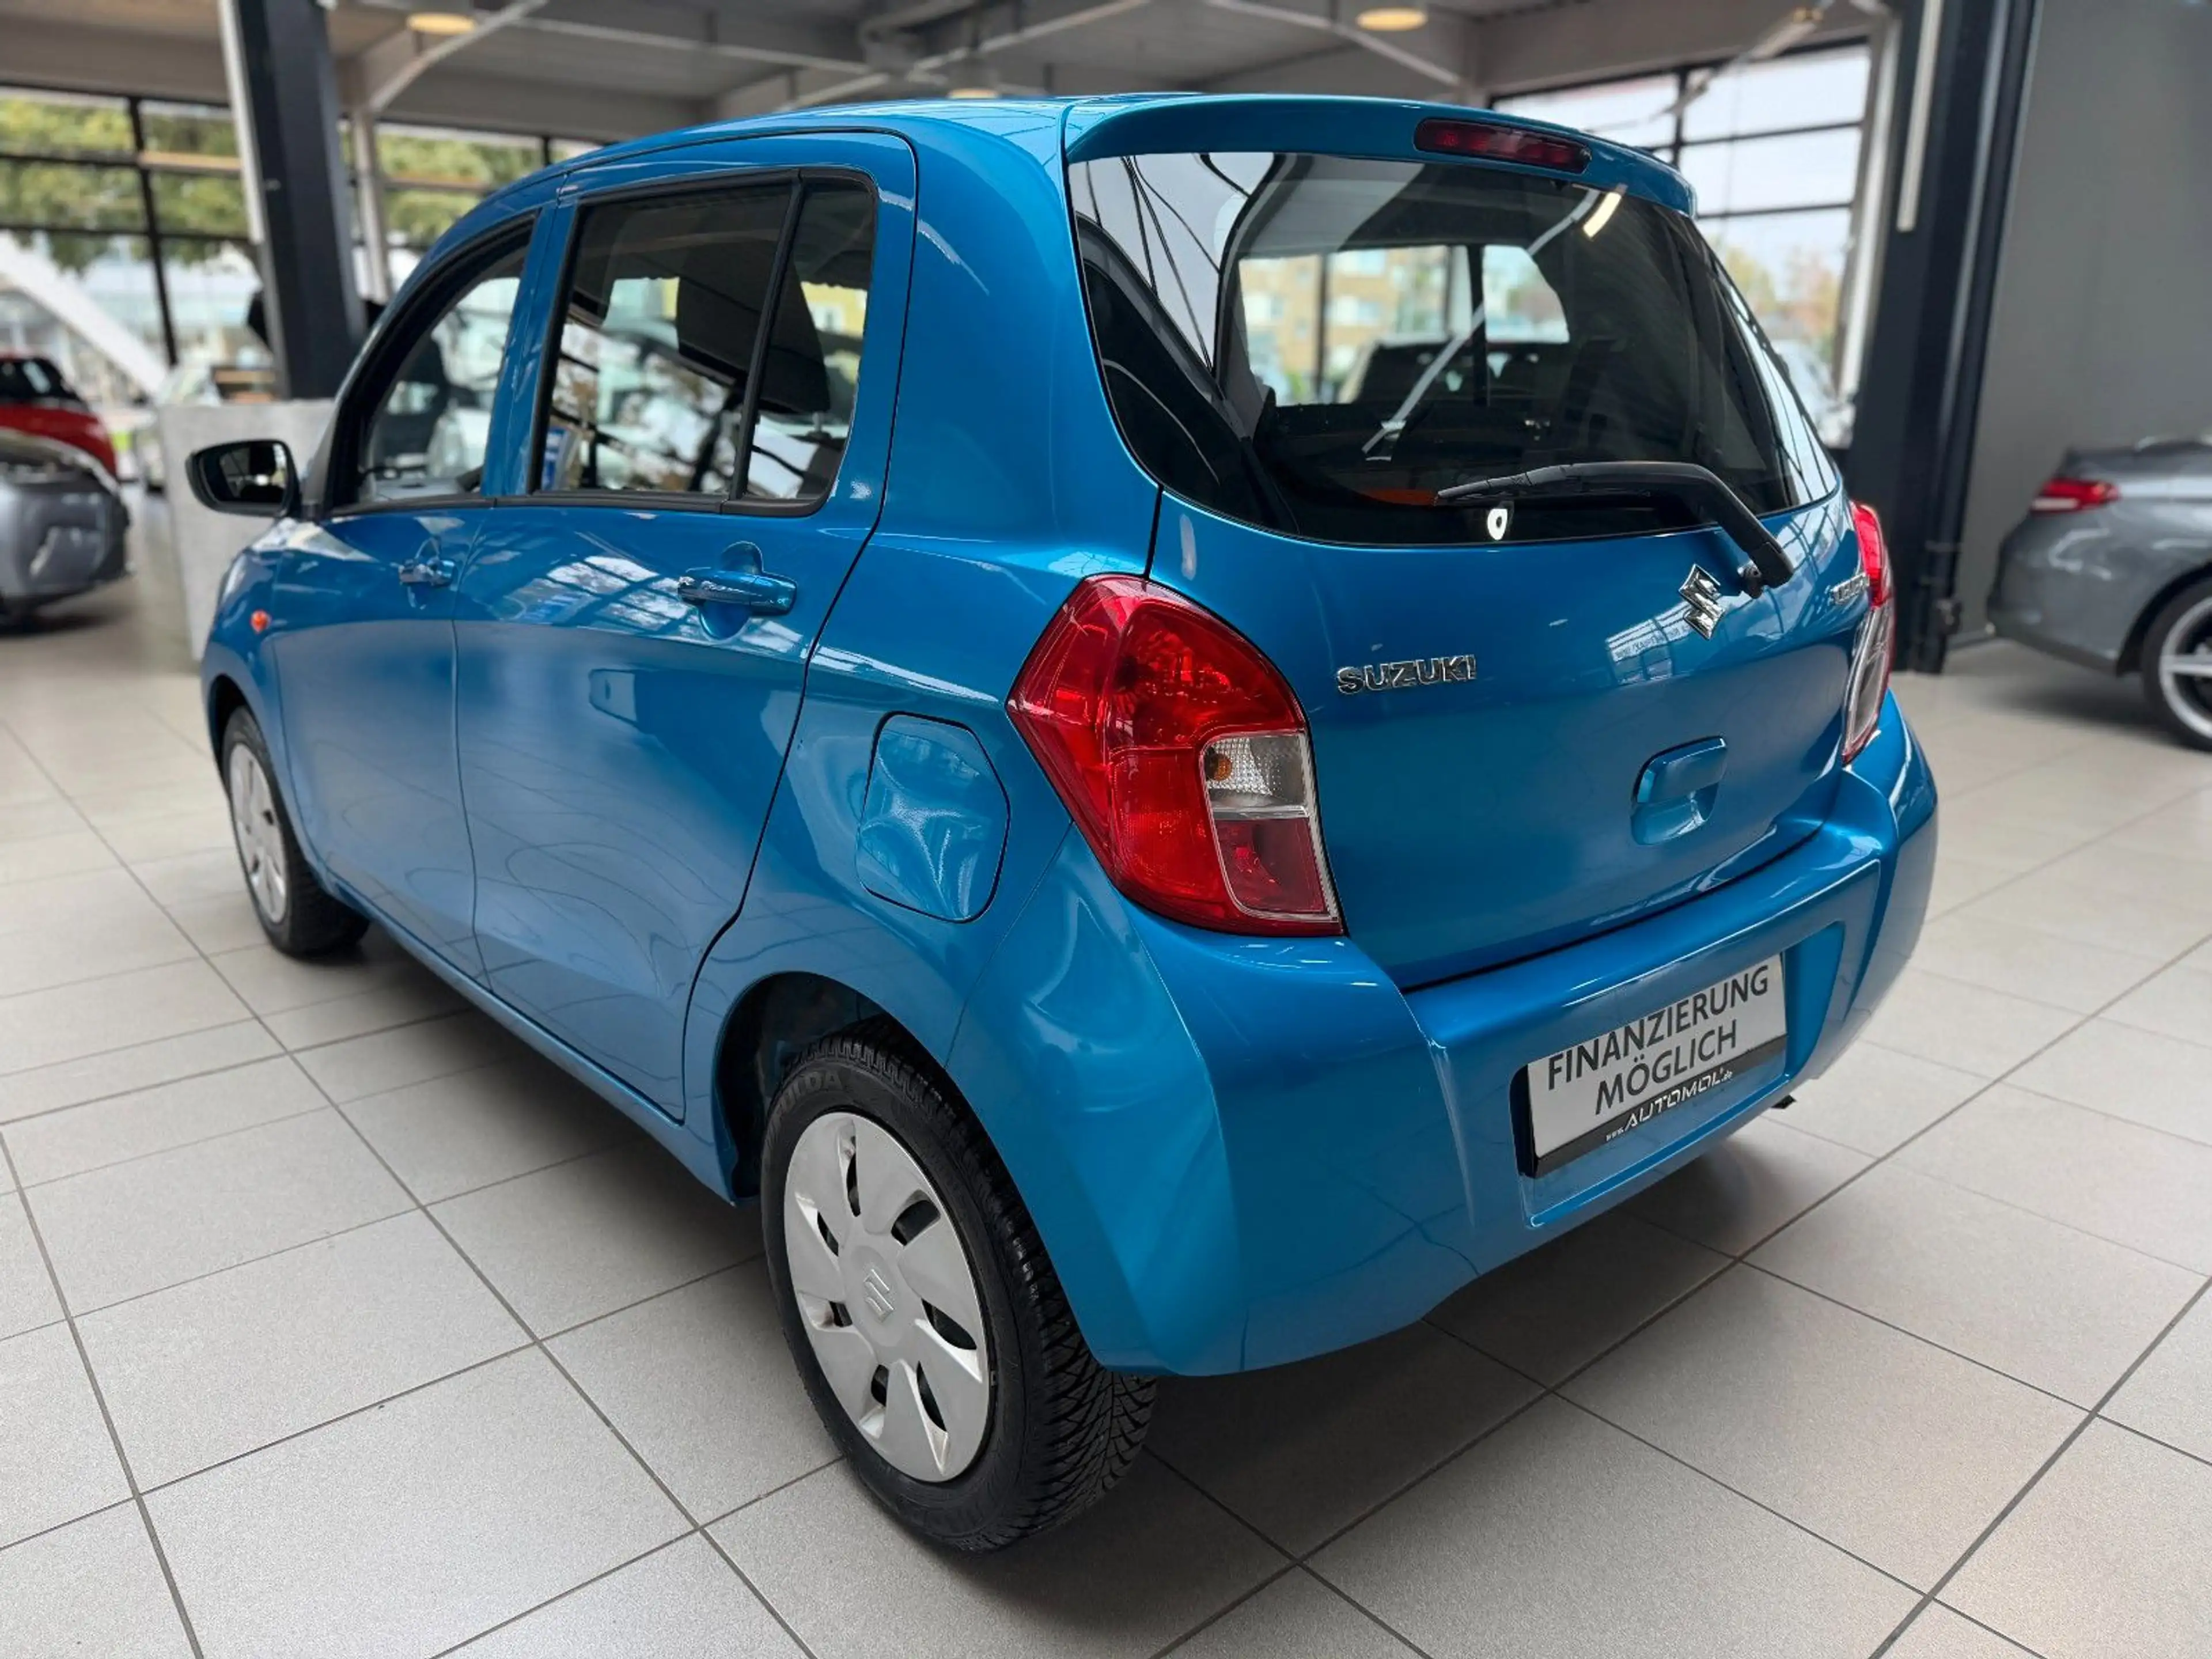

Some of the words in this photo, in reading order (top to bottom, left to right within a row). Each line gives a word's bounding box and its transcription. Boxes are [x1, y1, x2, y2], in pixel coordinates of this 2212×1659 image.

[1336, 654, 1476, 695] SUZUKI
[1548, 965, 1768, 1090] FINANZIERUNG
[1595, 1019, 1737, 1115] MÖGLICH
